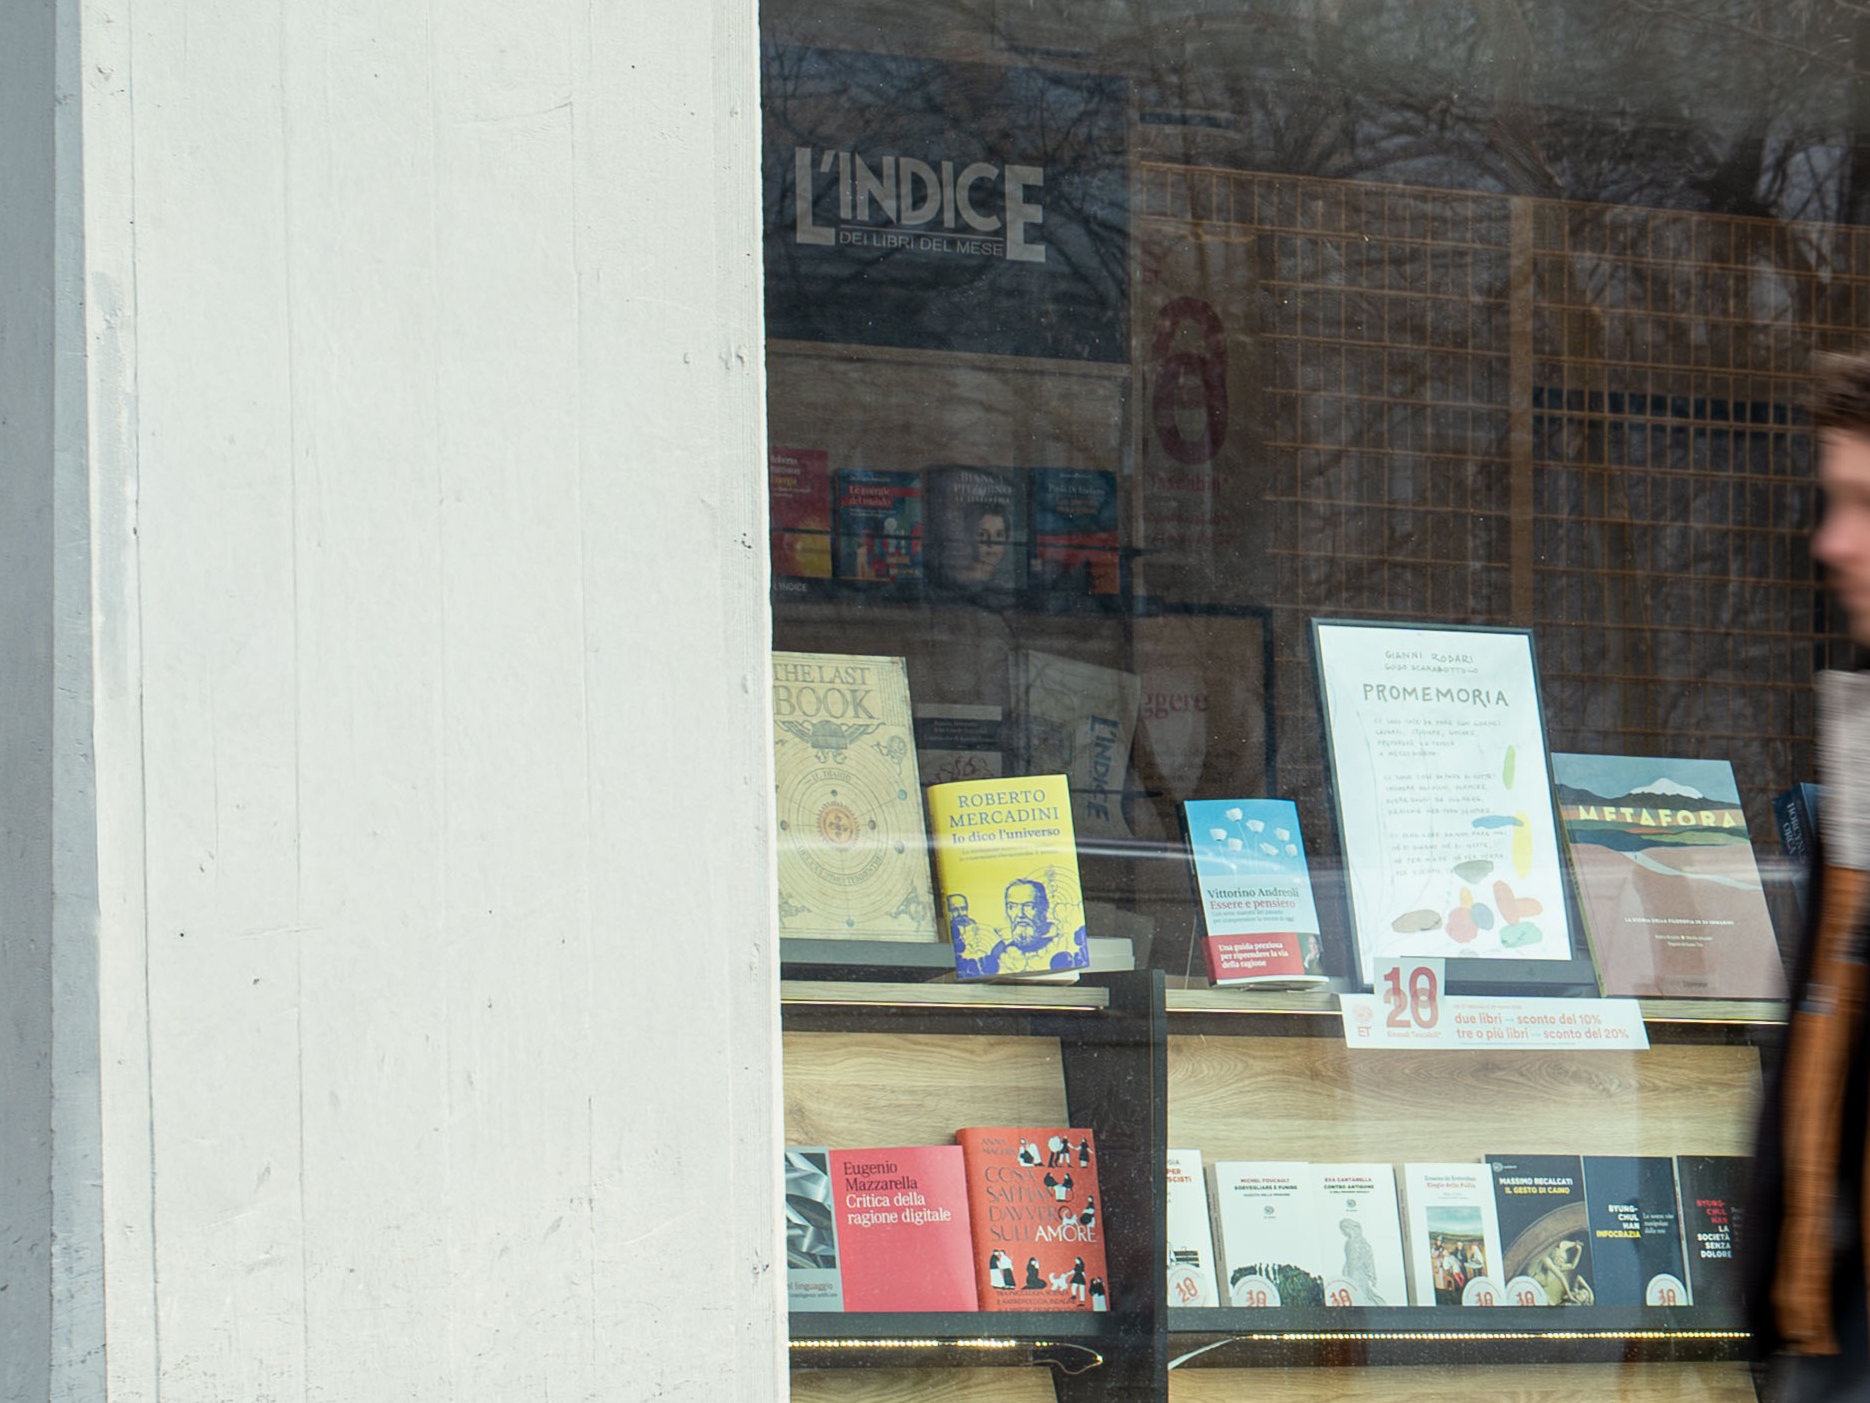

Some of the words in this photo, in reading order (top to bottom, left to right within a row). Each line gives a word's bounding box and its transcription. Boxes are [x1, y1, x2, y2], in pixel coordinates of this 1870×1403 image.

[795, 147, 1046, 263] L'INDICE
[839, 231, 867, 246] DEI
[872, 233, 914, 249] LIBRI
[919, 236, 952, 252] DEL
[956, 239, 1004, 257] MESE
[1385, 650, 1423, 660] GIANNI
[1431, 652, 1474, 664] RODARI
[773, 663, 813, 683] THE
[817, 667, 871, 685] LAST
[774, 685, 875, 720] BOOK
[1362, 683, 1510, 709] PROMEMORIA
[958, 789, 1046, 809] ROBERTO
[950, 807, 1059, 829] MERCADINI
[1578, 804, 1737, 829] METAFORA
[952, 833, 965, 844] Io
[968, 830, 996, 843] dico
[1000, 827, 1060, 840] l'universo
[1207, 887, 1256, 899] Vittorino
[1257, 886, 1300, 898] Andreoli
[1209, 900, 1244, 910] Essere
[1254, 899, 1296, 910] pensiero
[1455, 1013, 1477, 1024] due
[1479, 1012, 1503, 1024] libri
[1517, 1014, 1556, 1025] sconto
[1558, 1013, 1577, 1025] del
[1579, 1014, 1602, 1025] 10%
[1357, 1026, 1372, 1038] ET
[1456, 1028, 1474, 1039] tre
[1476, 1030, 1483, 1039] o
[1486, 1028, 1504, 1042] più
[1506, 1027, 1529, 1039] libri
[1543, 1028, 1582, 1040] sconto
[1584, 1027, 1602, 1040] del
[1604, 1028, 1630, 1040] 20%
[843, 1161, 898, 1177] Eugenio
[985, 1166, 1037, 1183] COSA
[845, 1176, 919, 1192] Mazzarella
[1499, 1177, 1532, 1186] MASSIMO
[1534, 1177, 1573, 1186] RECALCATI
[1505, 1187, 1512, 1195] IL
[1513, 1187, 1538, 1195] GESTO
[1549, 1187, 1571, 1195] CAINO
[845, 1192, 891, 1208] Critica
[893, 1192, 926, 1207] della
[988, 1205, 1074, 1223] DAVVERO
[1607, 1204, 1639, 1213] BYUNG-
[848, 1212, 898, 1228] ragione
[901, 1207, 952, 1226] digitale
[1617, 1213, 1640, 1221] CHUL
[990, 1224, 1097, 1244] SULL'AMORE
[1622, 1222, 1640, 1230] HAN
[1718, 1225, 1730, 1233] LA
[1596, 1230, 1642, 1239] INFOCRAZIA
[1697, 1233, 1731, 1242] SOCIETÀ
[1700, 1250, 1733, 1258] DOLORE
